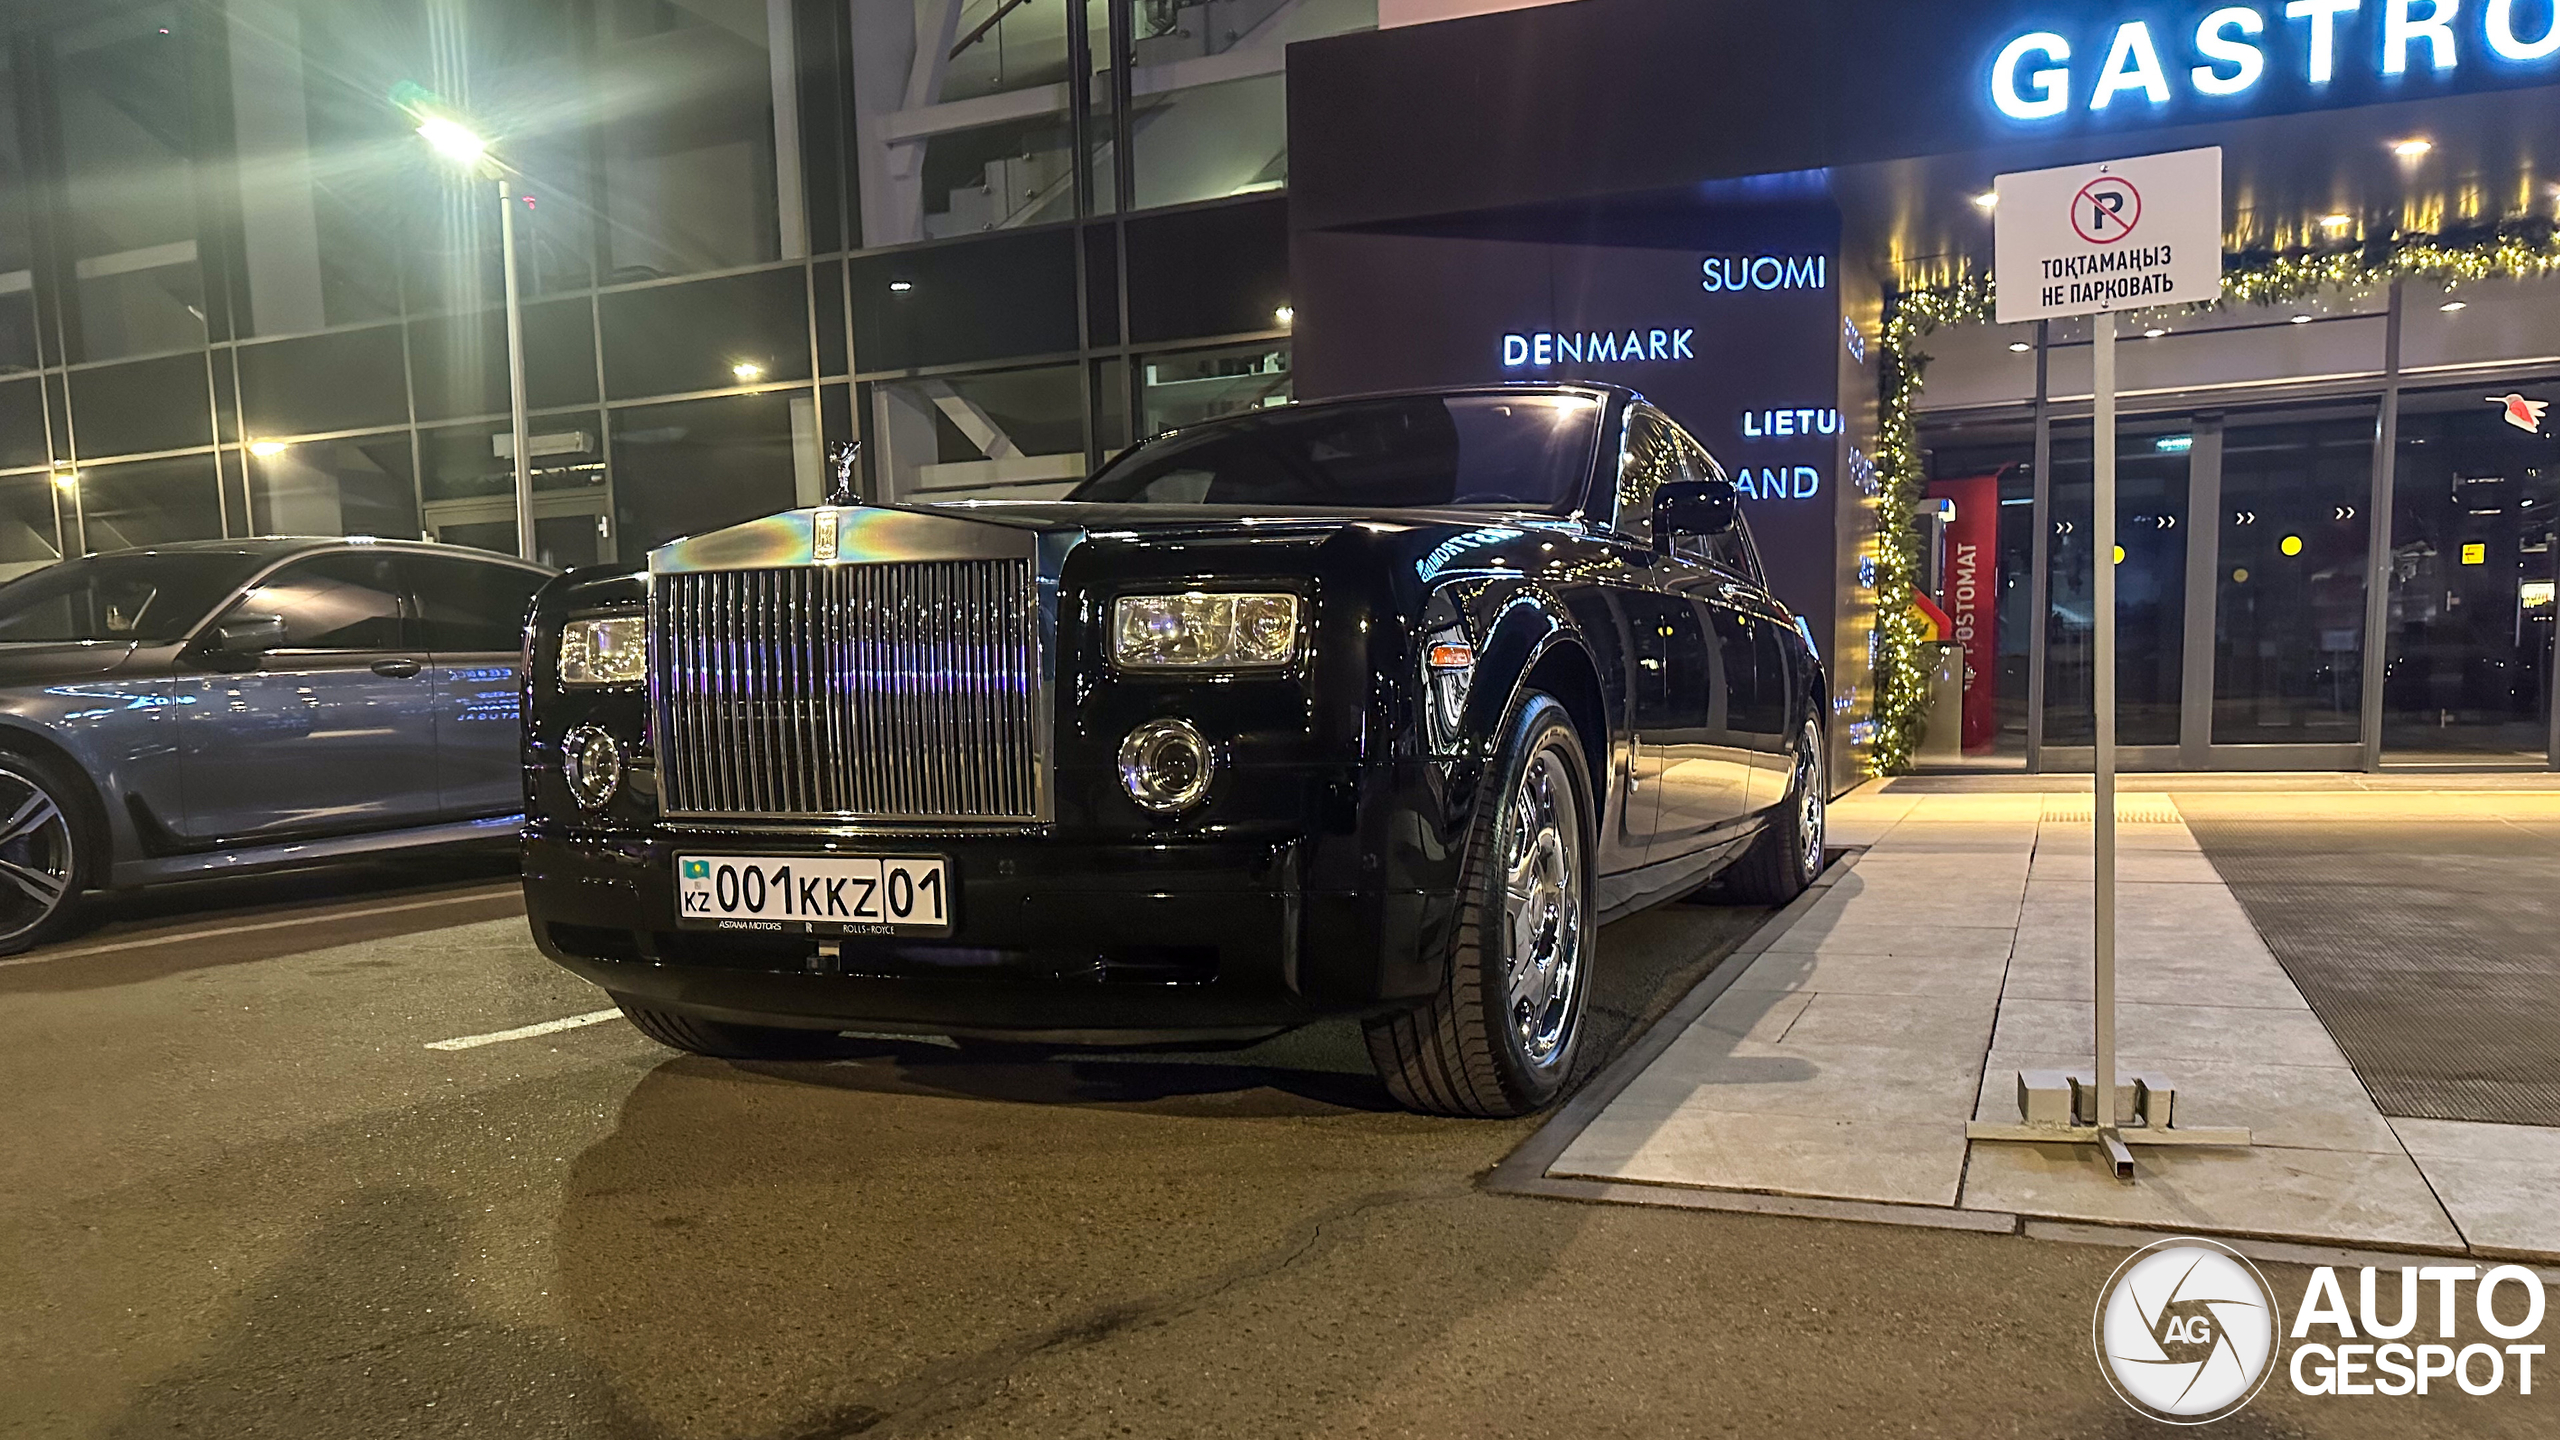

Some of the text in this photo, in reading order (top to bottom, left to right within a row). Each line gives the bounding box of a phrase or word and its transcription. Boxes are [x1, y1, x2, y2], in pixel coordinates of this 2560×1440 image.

[1991, 0, 2560, 119] GASTRO
[1702, 255, 1827, 292] SUOMI
[2041, 244, 2172, 280] ТОҚТАМАҢЫЗ
[2042, 272, 2174, 306] НЕ ПАРКОВАТЬ
[1504, 328, 1695, 367] DENMARK
[684, 864, 942, 919] KZ 001KKZ 01
[719, 920, 782, 931] ASTANA MOTORS
[843, 924, 895, 935] ROLLS-ROYCE
